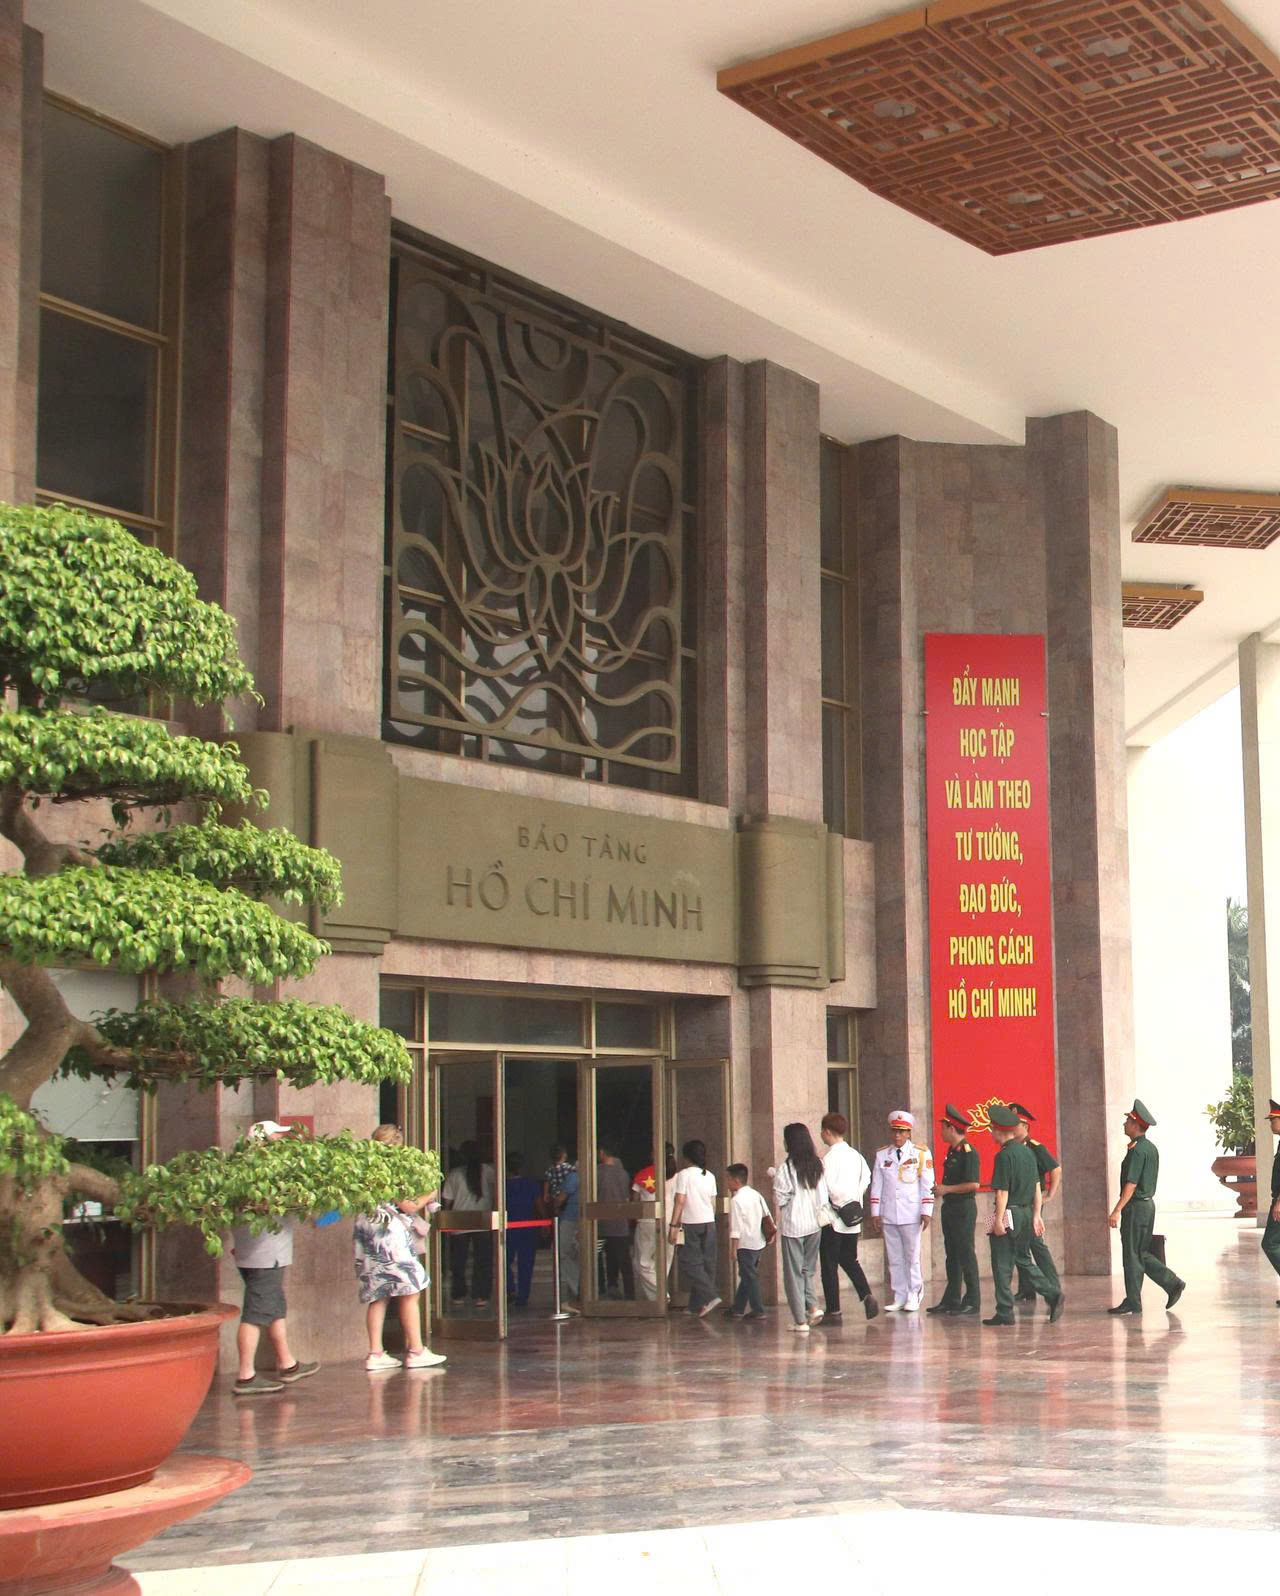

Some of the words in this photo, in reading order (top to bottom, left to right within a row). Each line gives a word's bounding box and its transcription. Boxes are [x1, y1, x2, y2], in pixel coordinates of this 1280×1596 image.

[952, 664, 977, 706] ĐẨY
[981, 678, 1020, 713] MẠNH
[960, 729, 987, 764] HỌC
[991, 722, 1015, 764] TẬP
[945, 773, 962, 808] VÀ
[966, 773, 994, 808] LÀM
[998, 780, 1031, 808] THEO
[582, 834, 646, 864] TÀNG
[955, 827, 973, 861] TƯ
[976, 822, 1024, 865] TƯỞNG,
[446, 860, 510, 911] HỒ
[525, 874, 591, 920] CHÍ
[607, 884, 703, 931] MINH
[960, 883, 986, 920] ĐẠO
[990, 876, 1022, 917] ĐỨC,
[950, 936, 994, 965] PHONG
[999, 928, 1033, 965] CÁCH
[949, 978, 967, 1019] HỒ
[971, 981, 994, 1018] CHÍ
[998, 987, 1037, 1017] MINH!
